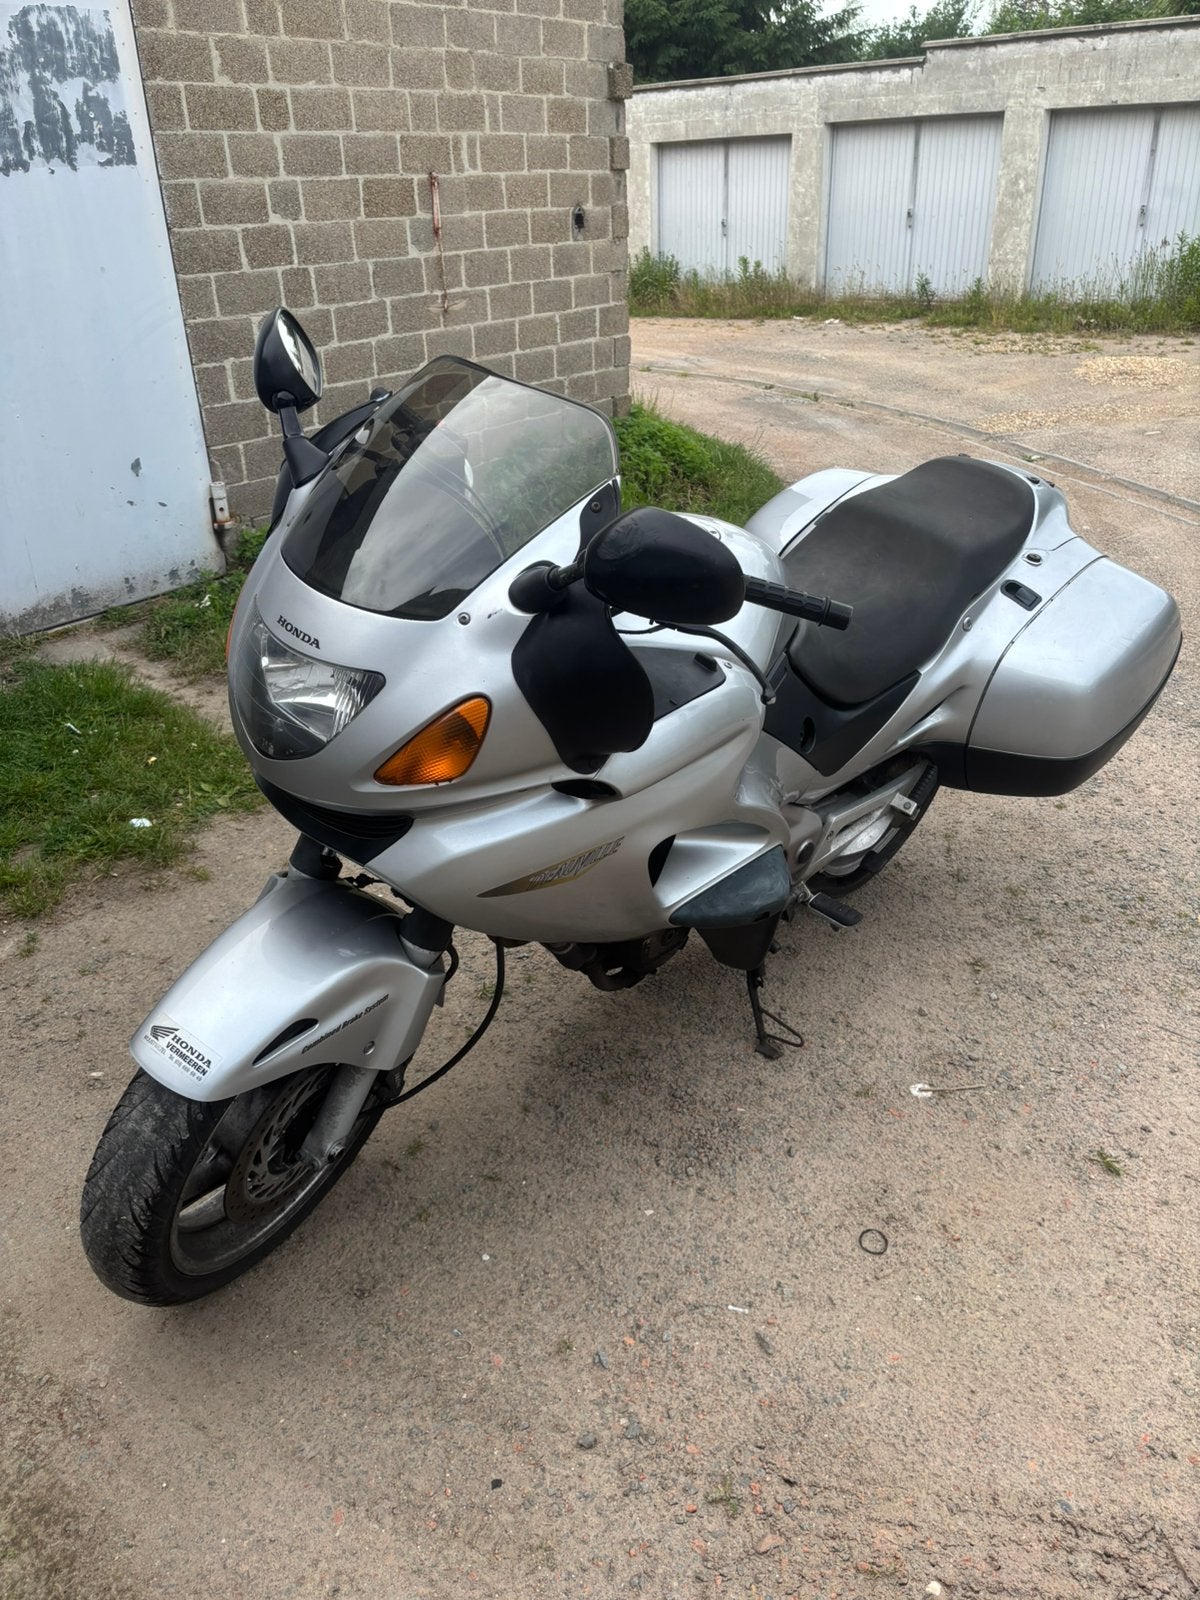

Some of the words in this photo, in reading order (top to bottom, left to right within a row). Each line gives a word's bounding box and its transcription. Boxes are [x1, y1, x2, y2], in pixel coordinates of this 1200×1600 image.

[277, 615, 321, 650] HONDA
[166, 1041, 208, 1076] VERMEEREN
[171, 1034, 212, 1068] HONDA
